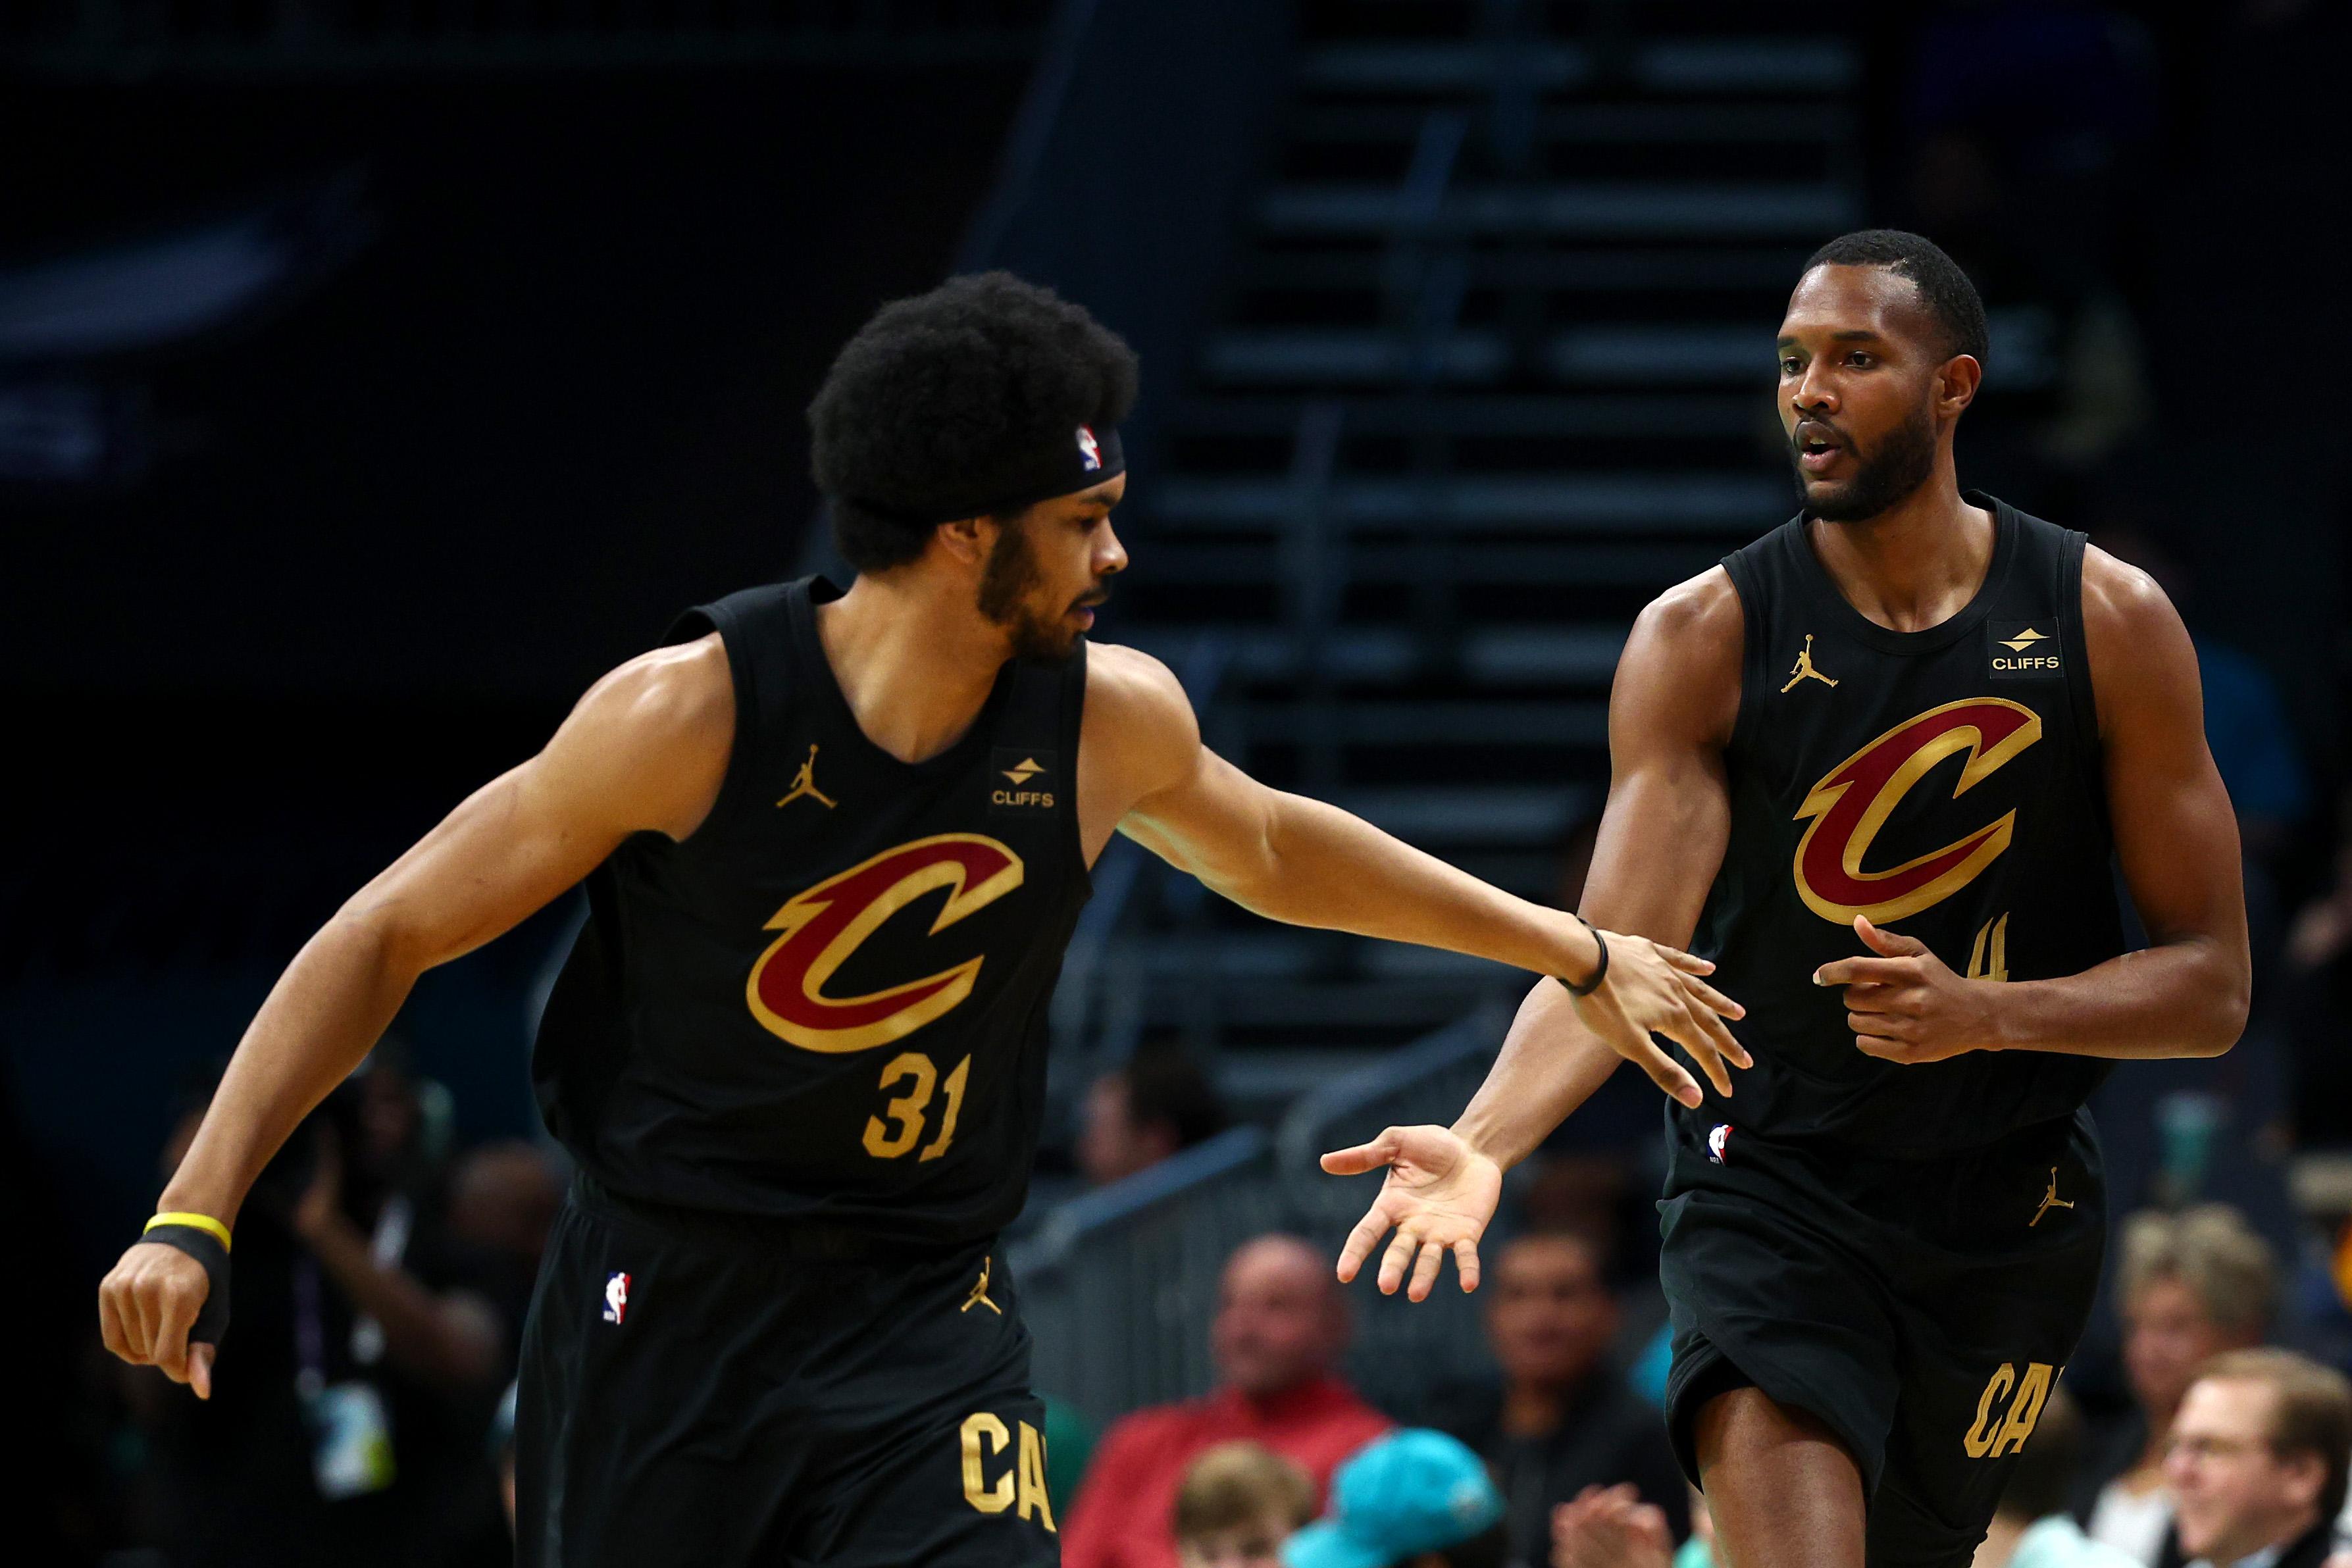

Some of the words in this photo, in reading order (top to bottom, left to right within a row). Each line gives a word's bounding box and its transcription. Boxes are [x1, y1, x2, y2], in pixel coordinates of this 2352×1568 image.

[1992, 656, 2059, 670] CLIFFS
[992, 790, 1054, 808] CLIFFS
[1966, 911, 2009, 982] 4
[862, 1052, 971, 1162] 31
[1964, 1362, 2065, 1458] CA
[959, 1412, 1057, 1533] CA
